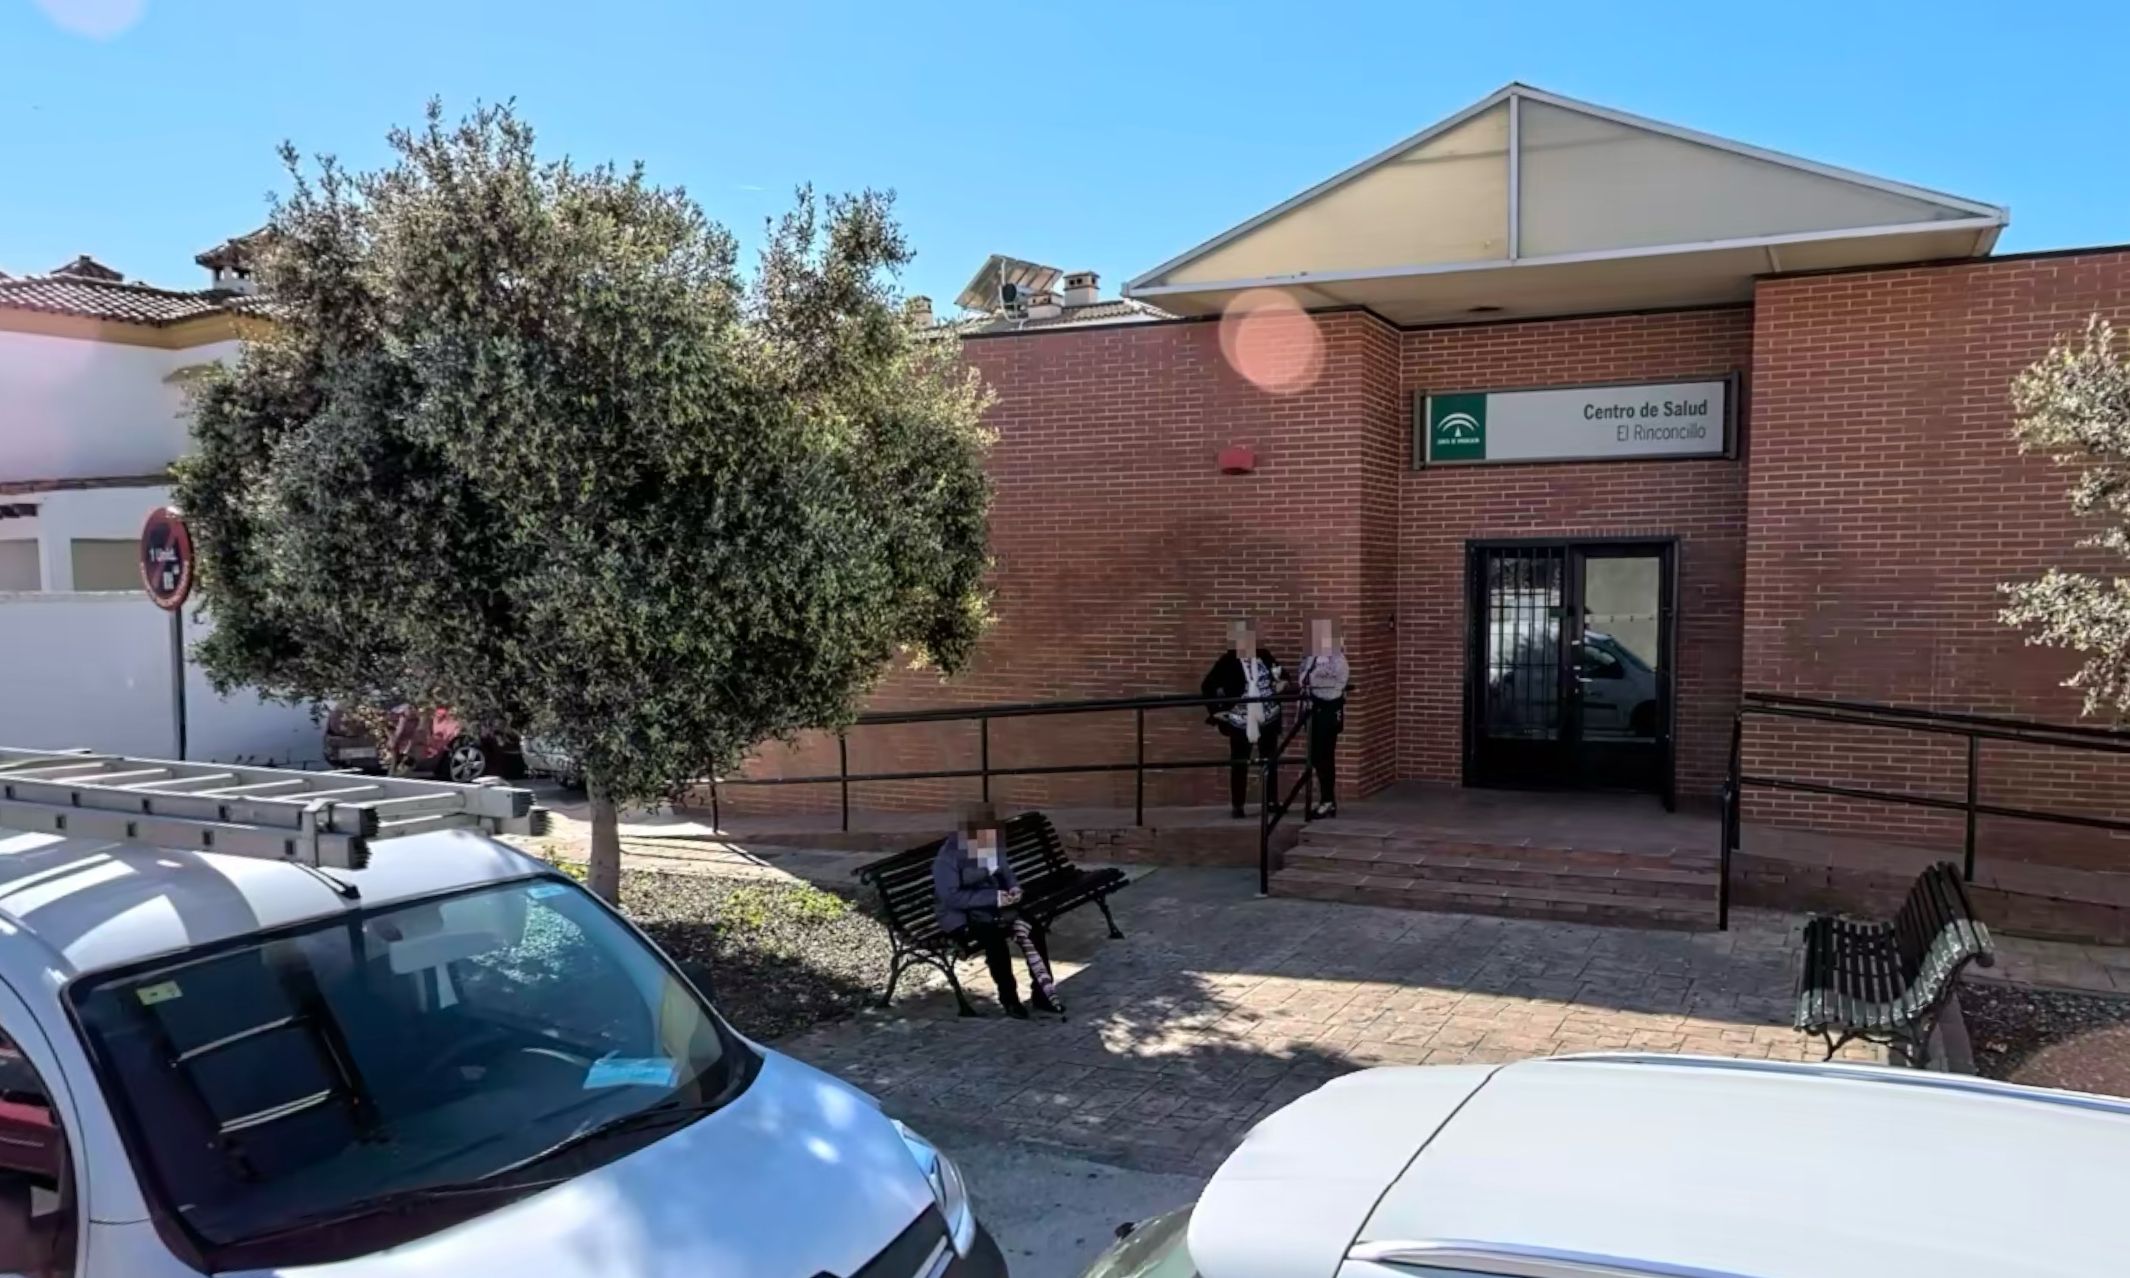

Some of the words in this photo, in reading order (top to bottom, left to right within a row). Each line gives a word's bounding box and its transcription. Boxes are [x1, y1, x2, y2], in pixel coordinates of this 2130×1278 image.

[1583, 403, 1635, 420] Centro
[1640, 401, 1659, 418] de
[1663, 399, 1708, 417] Salud
[1616, 424, 1629, 441] El
[1634, 422, 1706, 440] Rinconcillo
